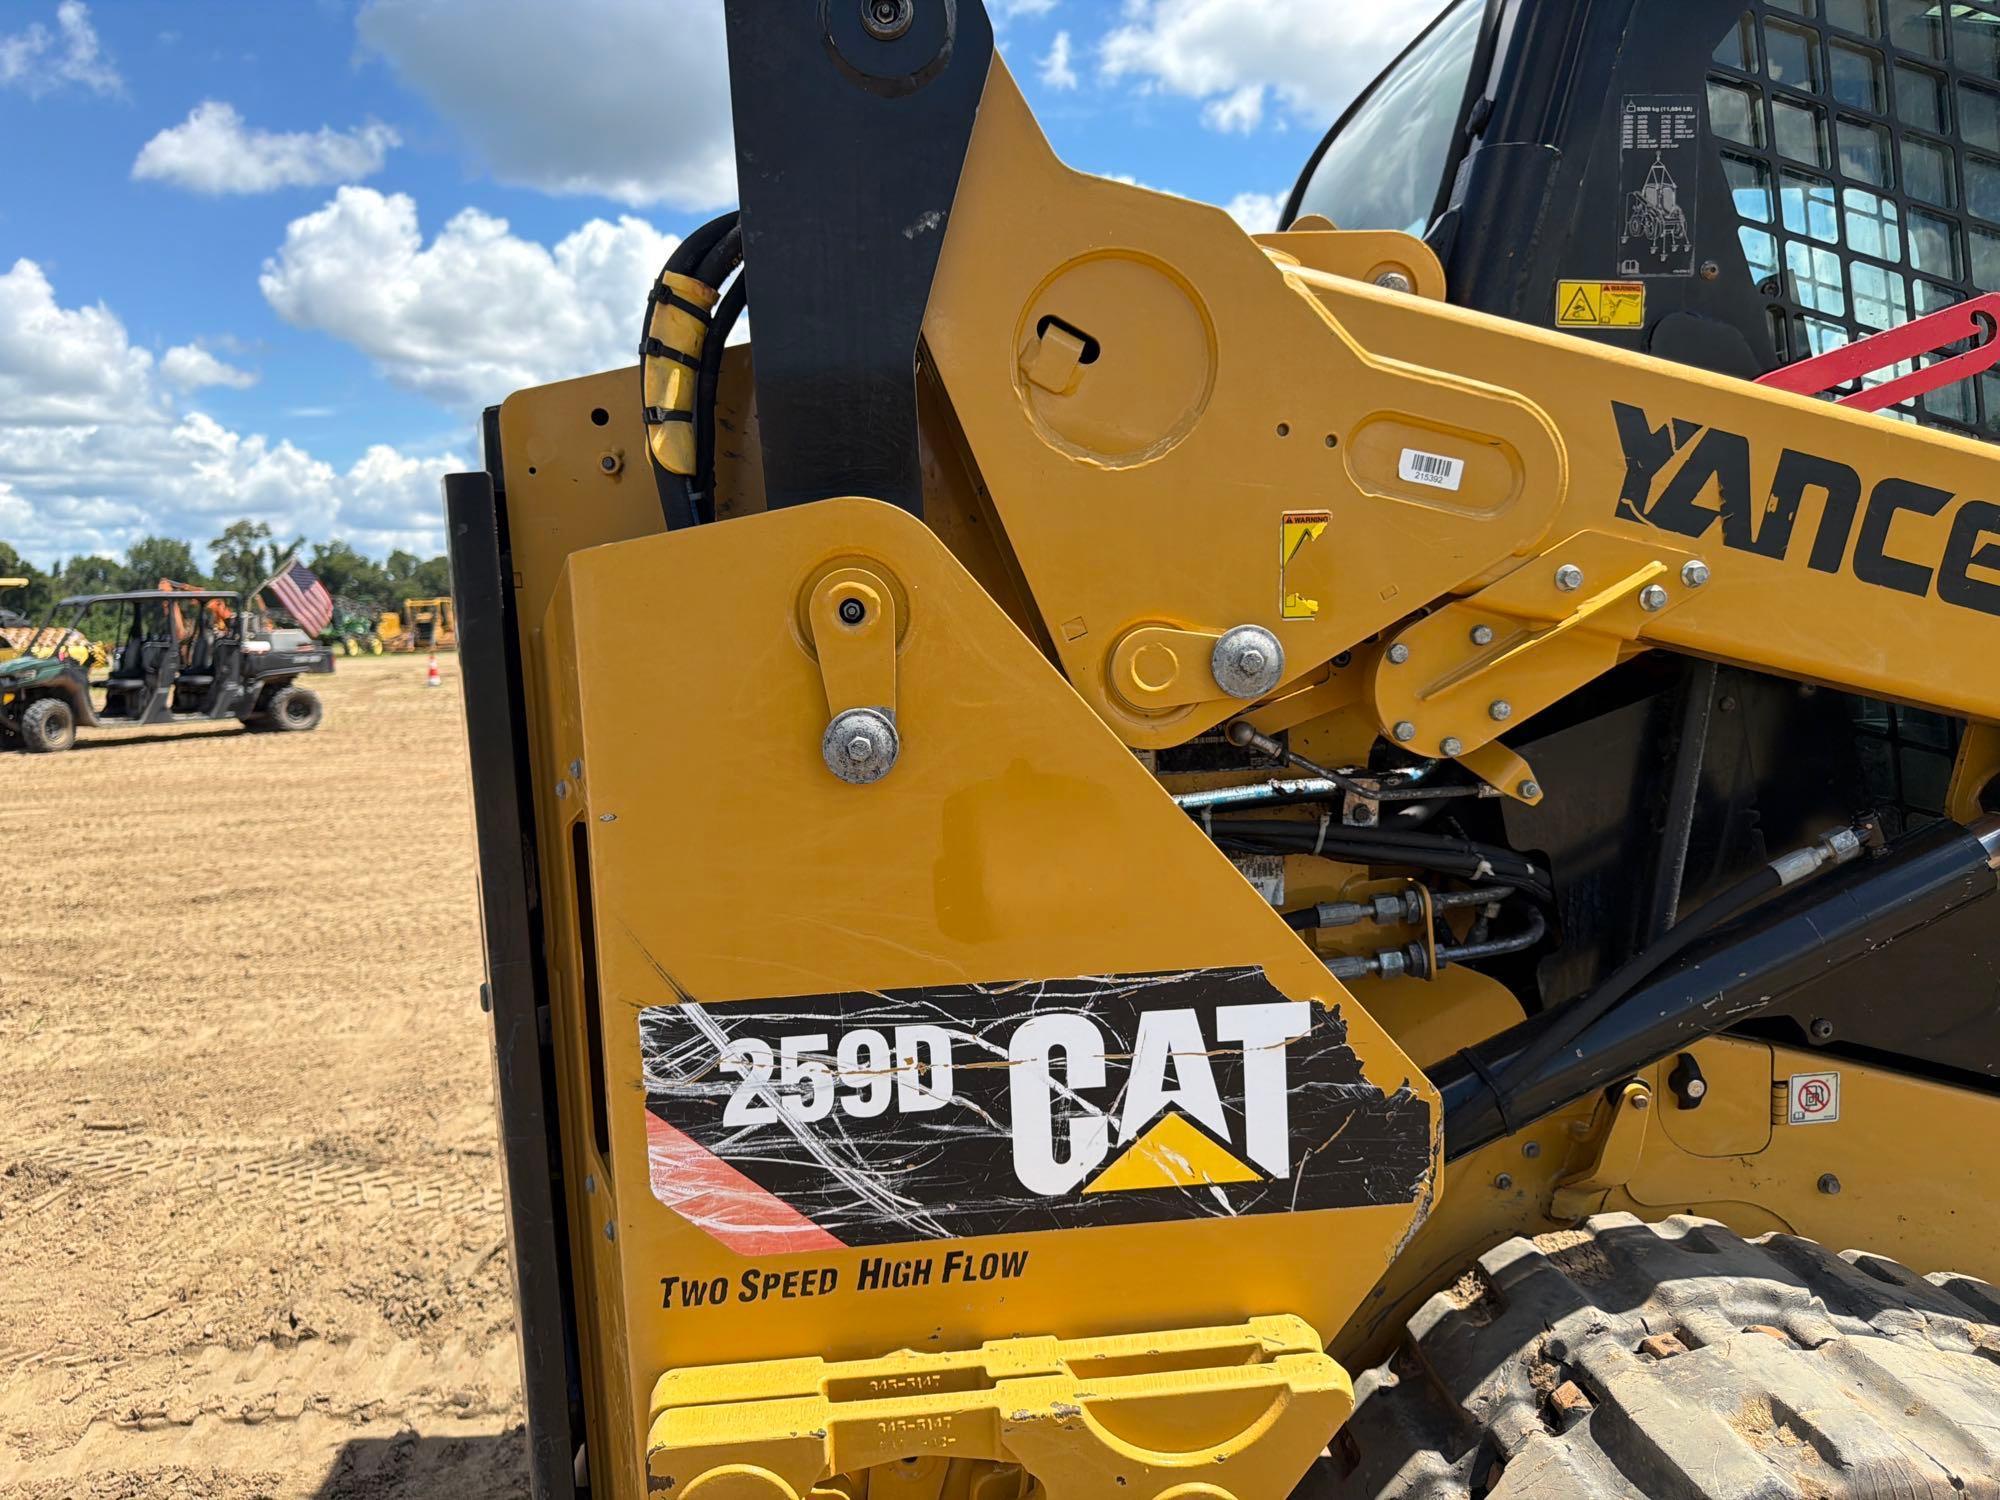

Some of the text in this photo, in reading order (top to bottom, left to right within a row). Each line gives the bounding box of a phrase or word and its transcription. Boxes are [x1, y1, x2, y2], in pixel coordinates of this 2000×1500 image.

[1414, 471, 1444, 484] 215392
[1294, 515, 1329, 524] WARNING
[720, 1001, 1311, 1196] 259D CAT
